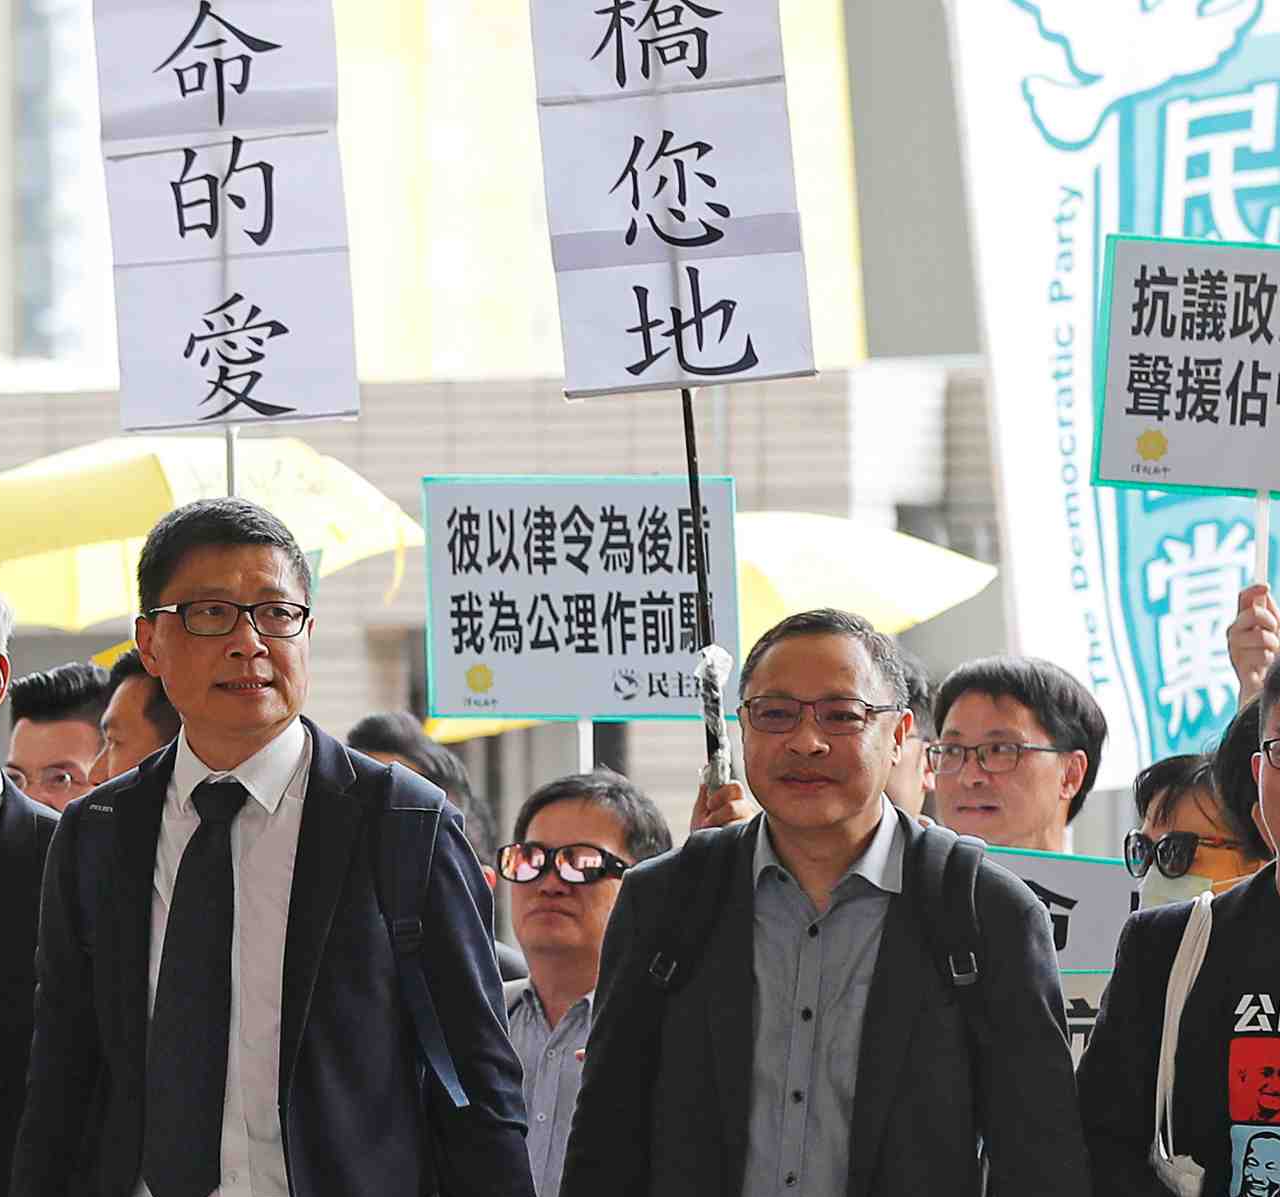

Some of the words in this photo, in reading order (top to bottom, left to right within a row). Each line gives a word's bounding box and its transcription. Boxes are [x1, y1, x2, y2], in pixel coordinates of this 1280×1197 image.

[153, 0, 297, 421] 命的愛
[590, 0, 760, 377] 橋您地
[1048, 184, 1084, 303] Party
[1050, 321, 1089, 591] Democratic
[647, 672, 704, 699] 民主
